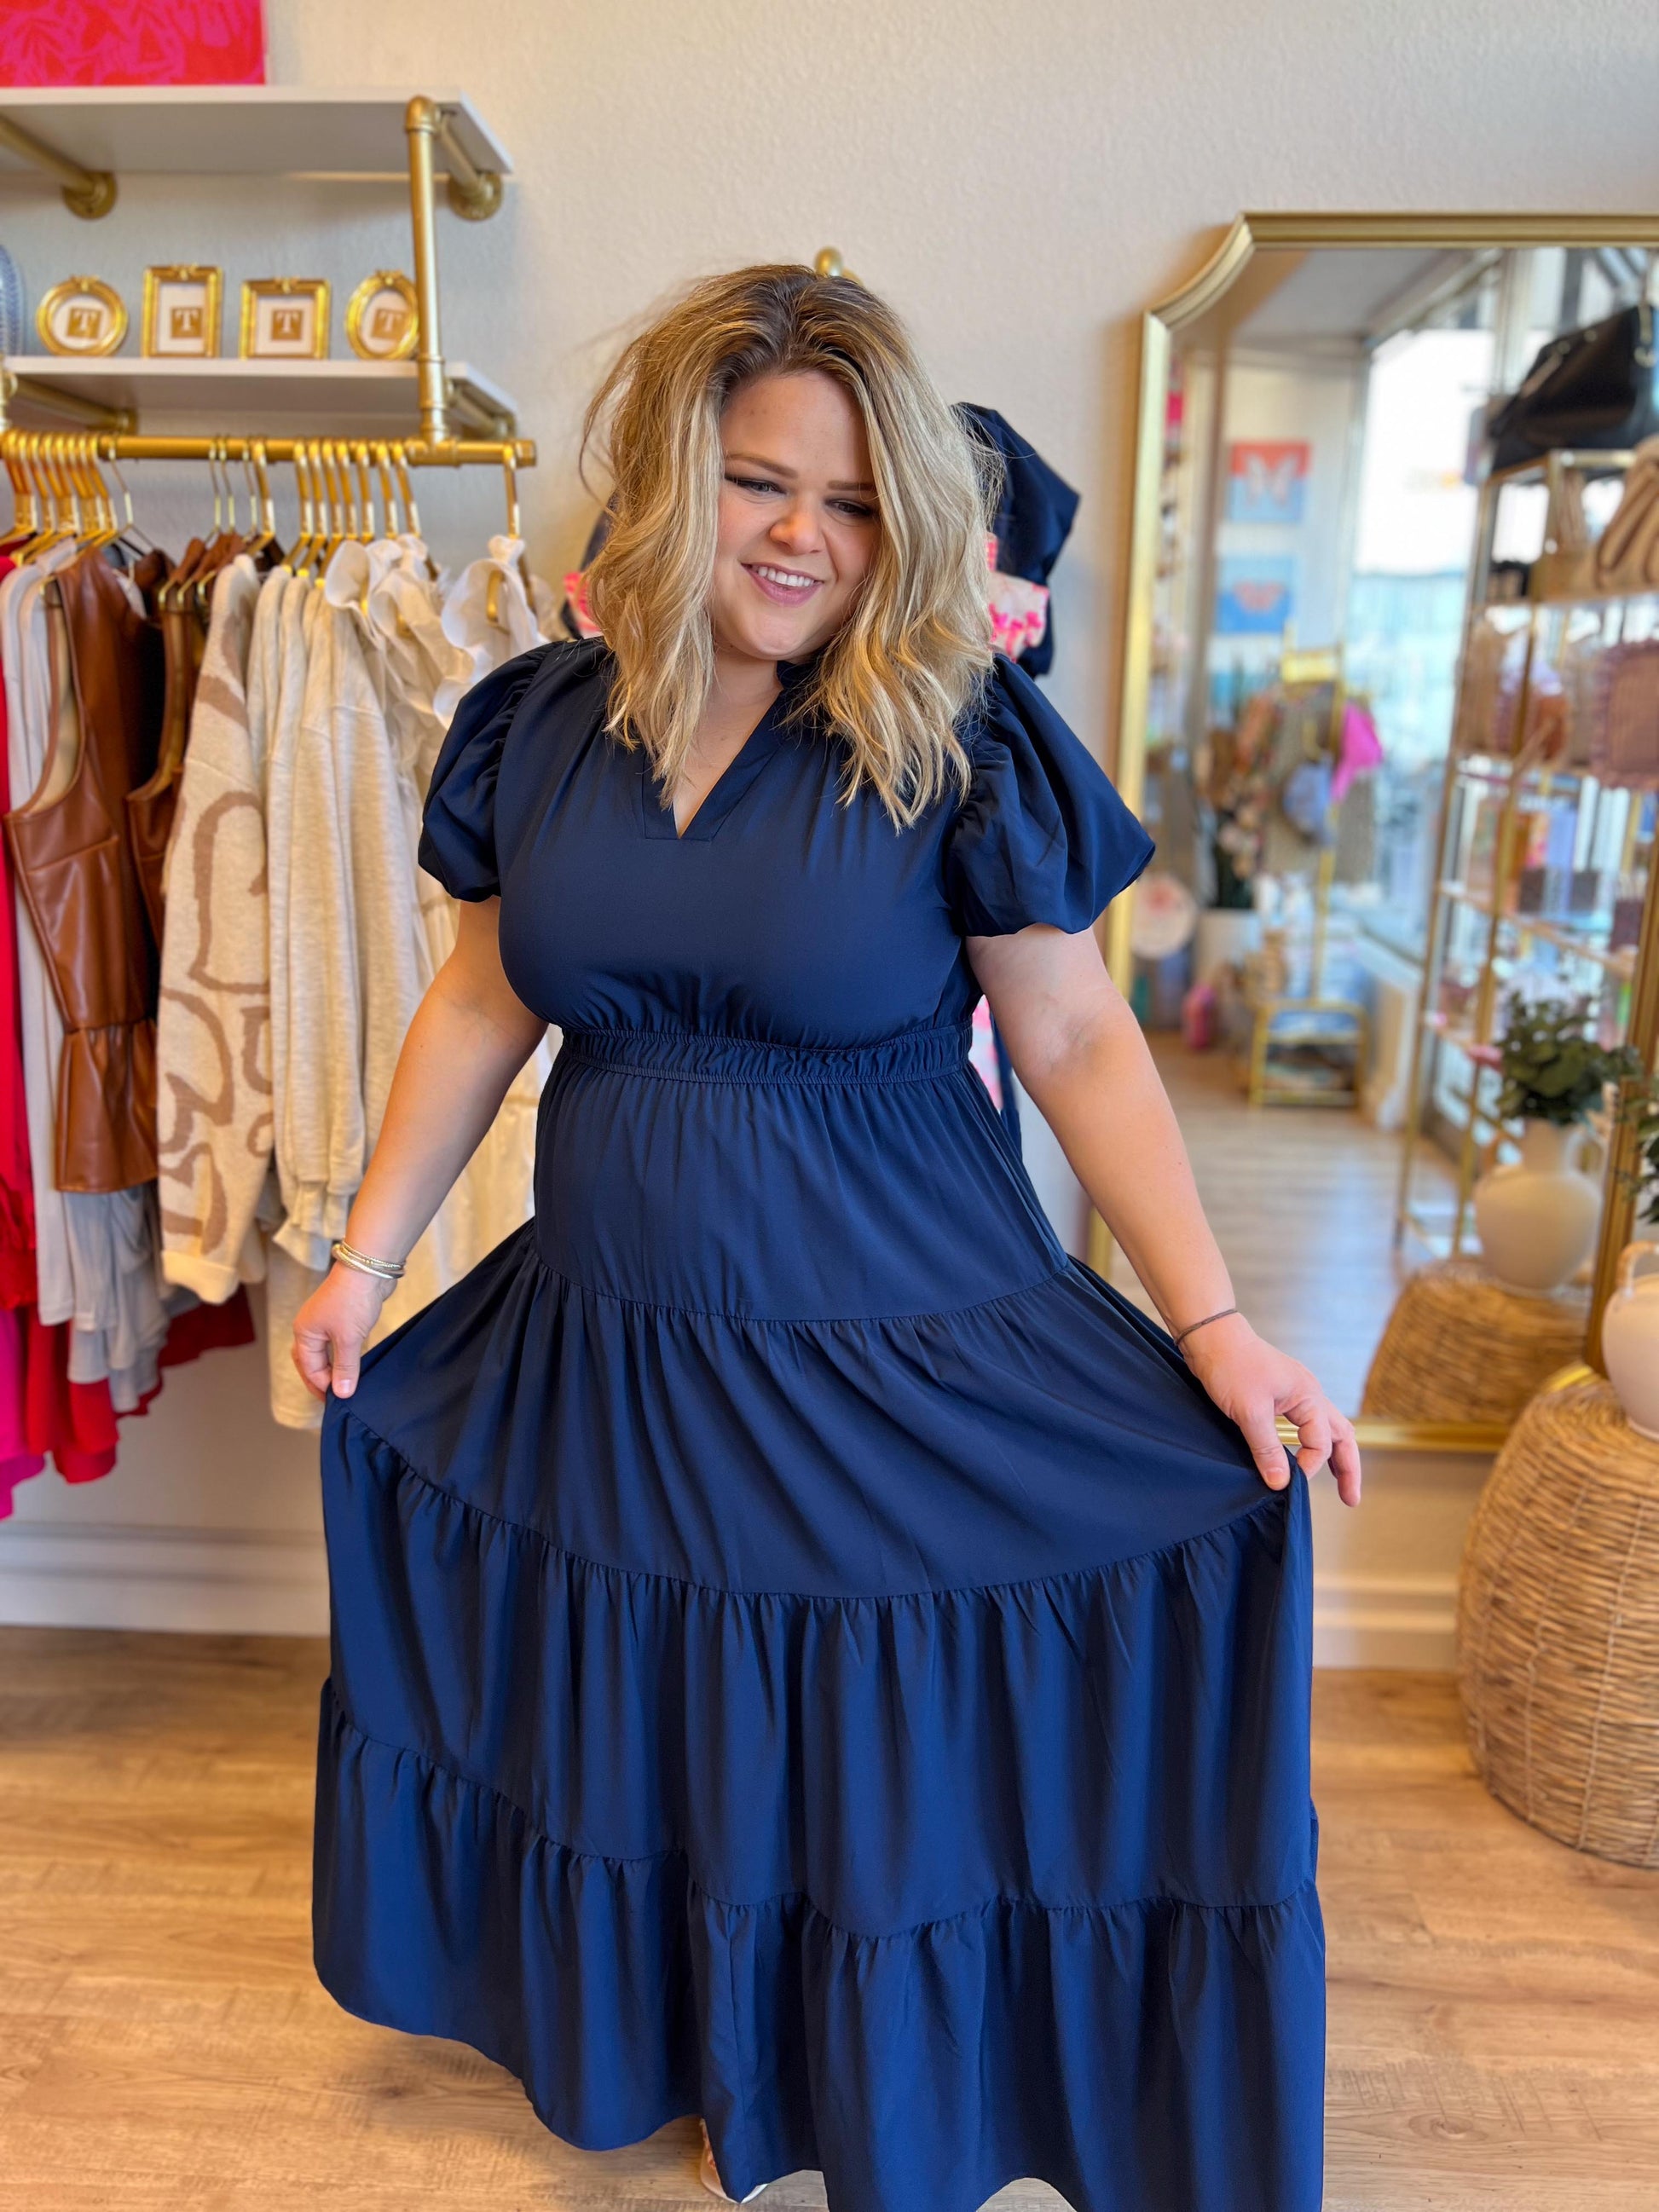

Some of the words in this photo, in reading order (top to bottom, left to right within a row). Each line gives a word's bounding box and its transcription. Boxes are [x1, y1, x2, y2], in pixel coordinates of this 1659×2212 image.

[73, 309, 98, 331] T
[175, 309, 199, 332] T
[276, 312, 300, 333] T
[379, 309, 403, 332] T
